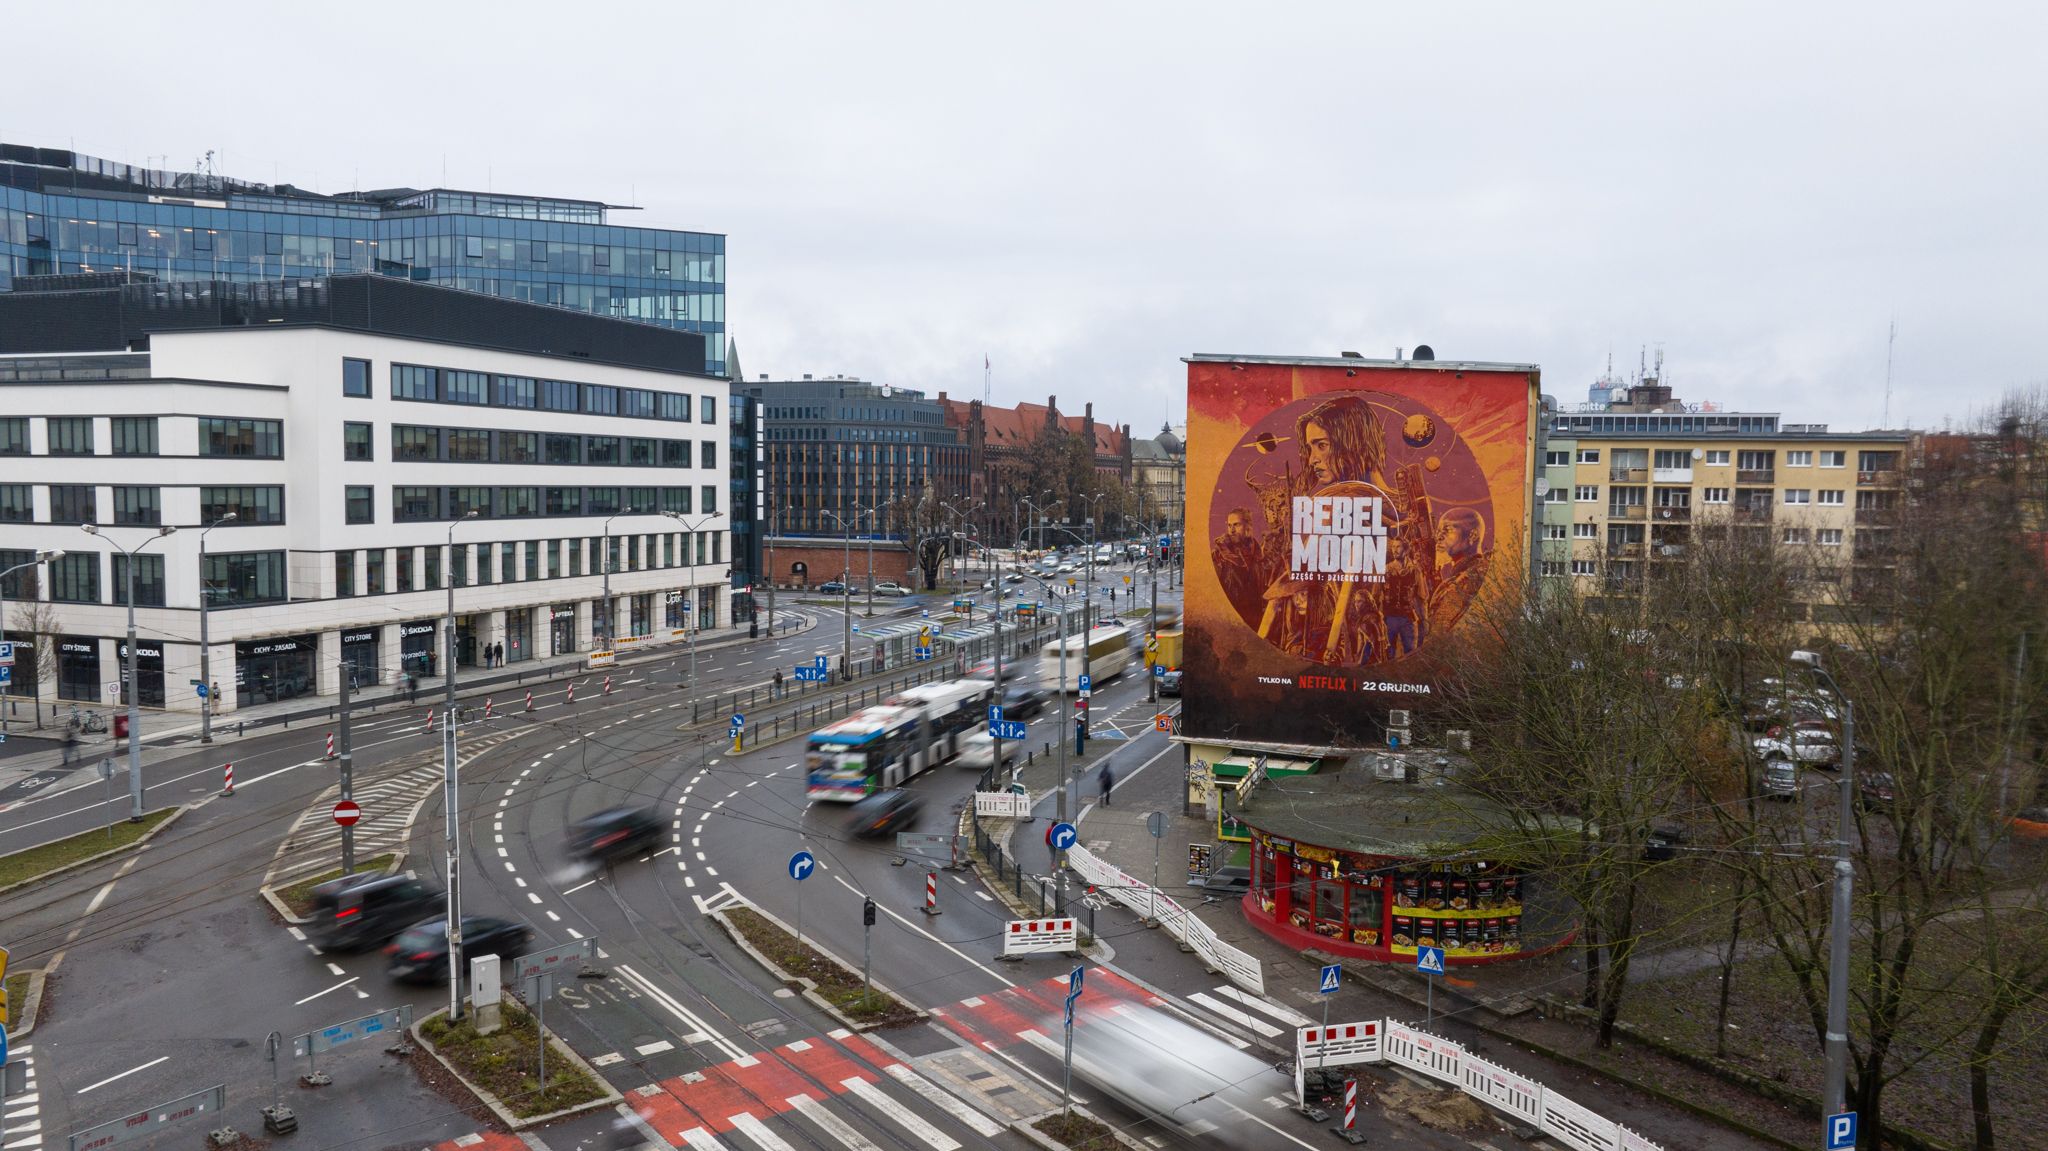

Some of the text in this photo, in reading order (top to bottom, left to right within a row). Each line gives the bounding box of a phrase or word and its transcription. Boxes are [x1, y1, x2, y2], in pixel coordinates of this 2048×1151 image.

[1292, 496, 1387, 535] REBEL
[1291, 534, 1387, 574] MOON
[1291, 572, 1314, 581] CZĘŚĆ
[1327, 574, 1359, 582] DZIECKO
[1363, 575, 1386, 583] OGNIA
[344, 635, 356, 643] CITY
[254, 646, 270, 654] CICHY
[274, 643, 296, 652] ZASADA
[1, 666, 9, 677] P
[1156, 667, 1163, 675] P
[1081, 676, 1088, 686] P
[1258, 676, 1280, 684] TYLKO
[1298, 675, 1347, 691] NETFLIX
[1362, 681, 1376, 691] 22
[1378, 682, 1431, 694] GRUDNIA
[730, 729, 737, 737] Z
[1431, 863, 1472, 873] MEGA
[1834, 1117, 1850, 1145] P
